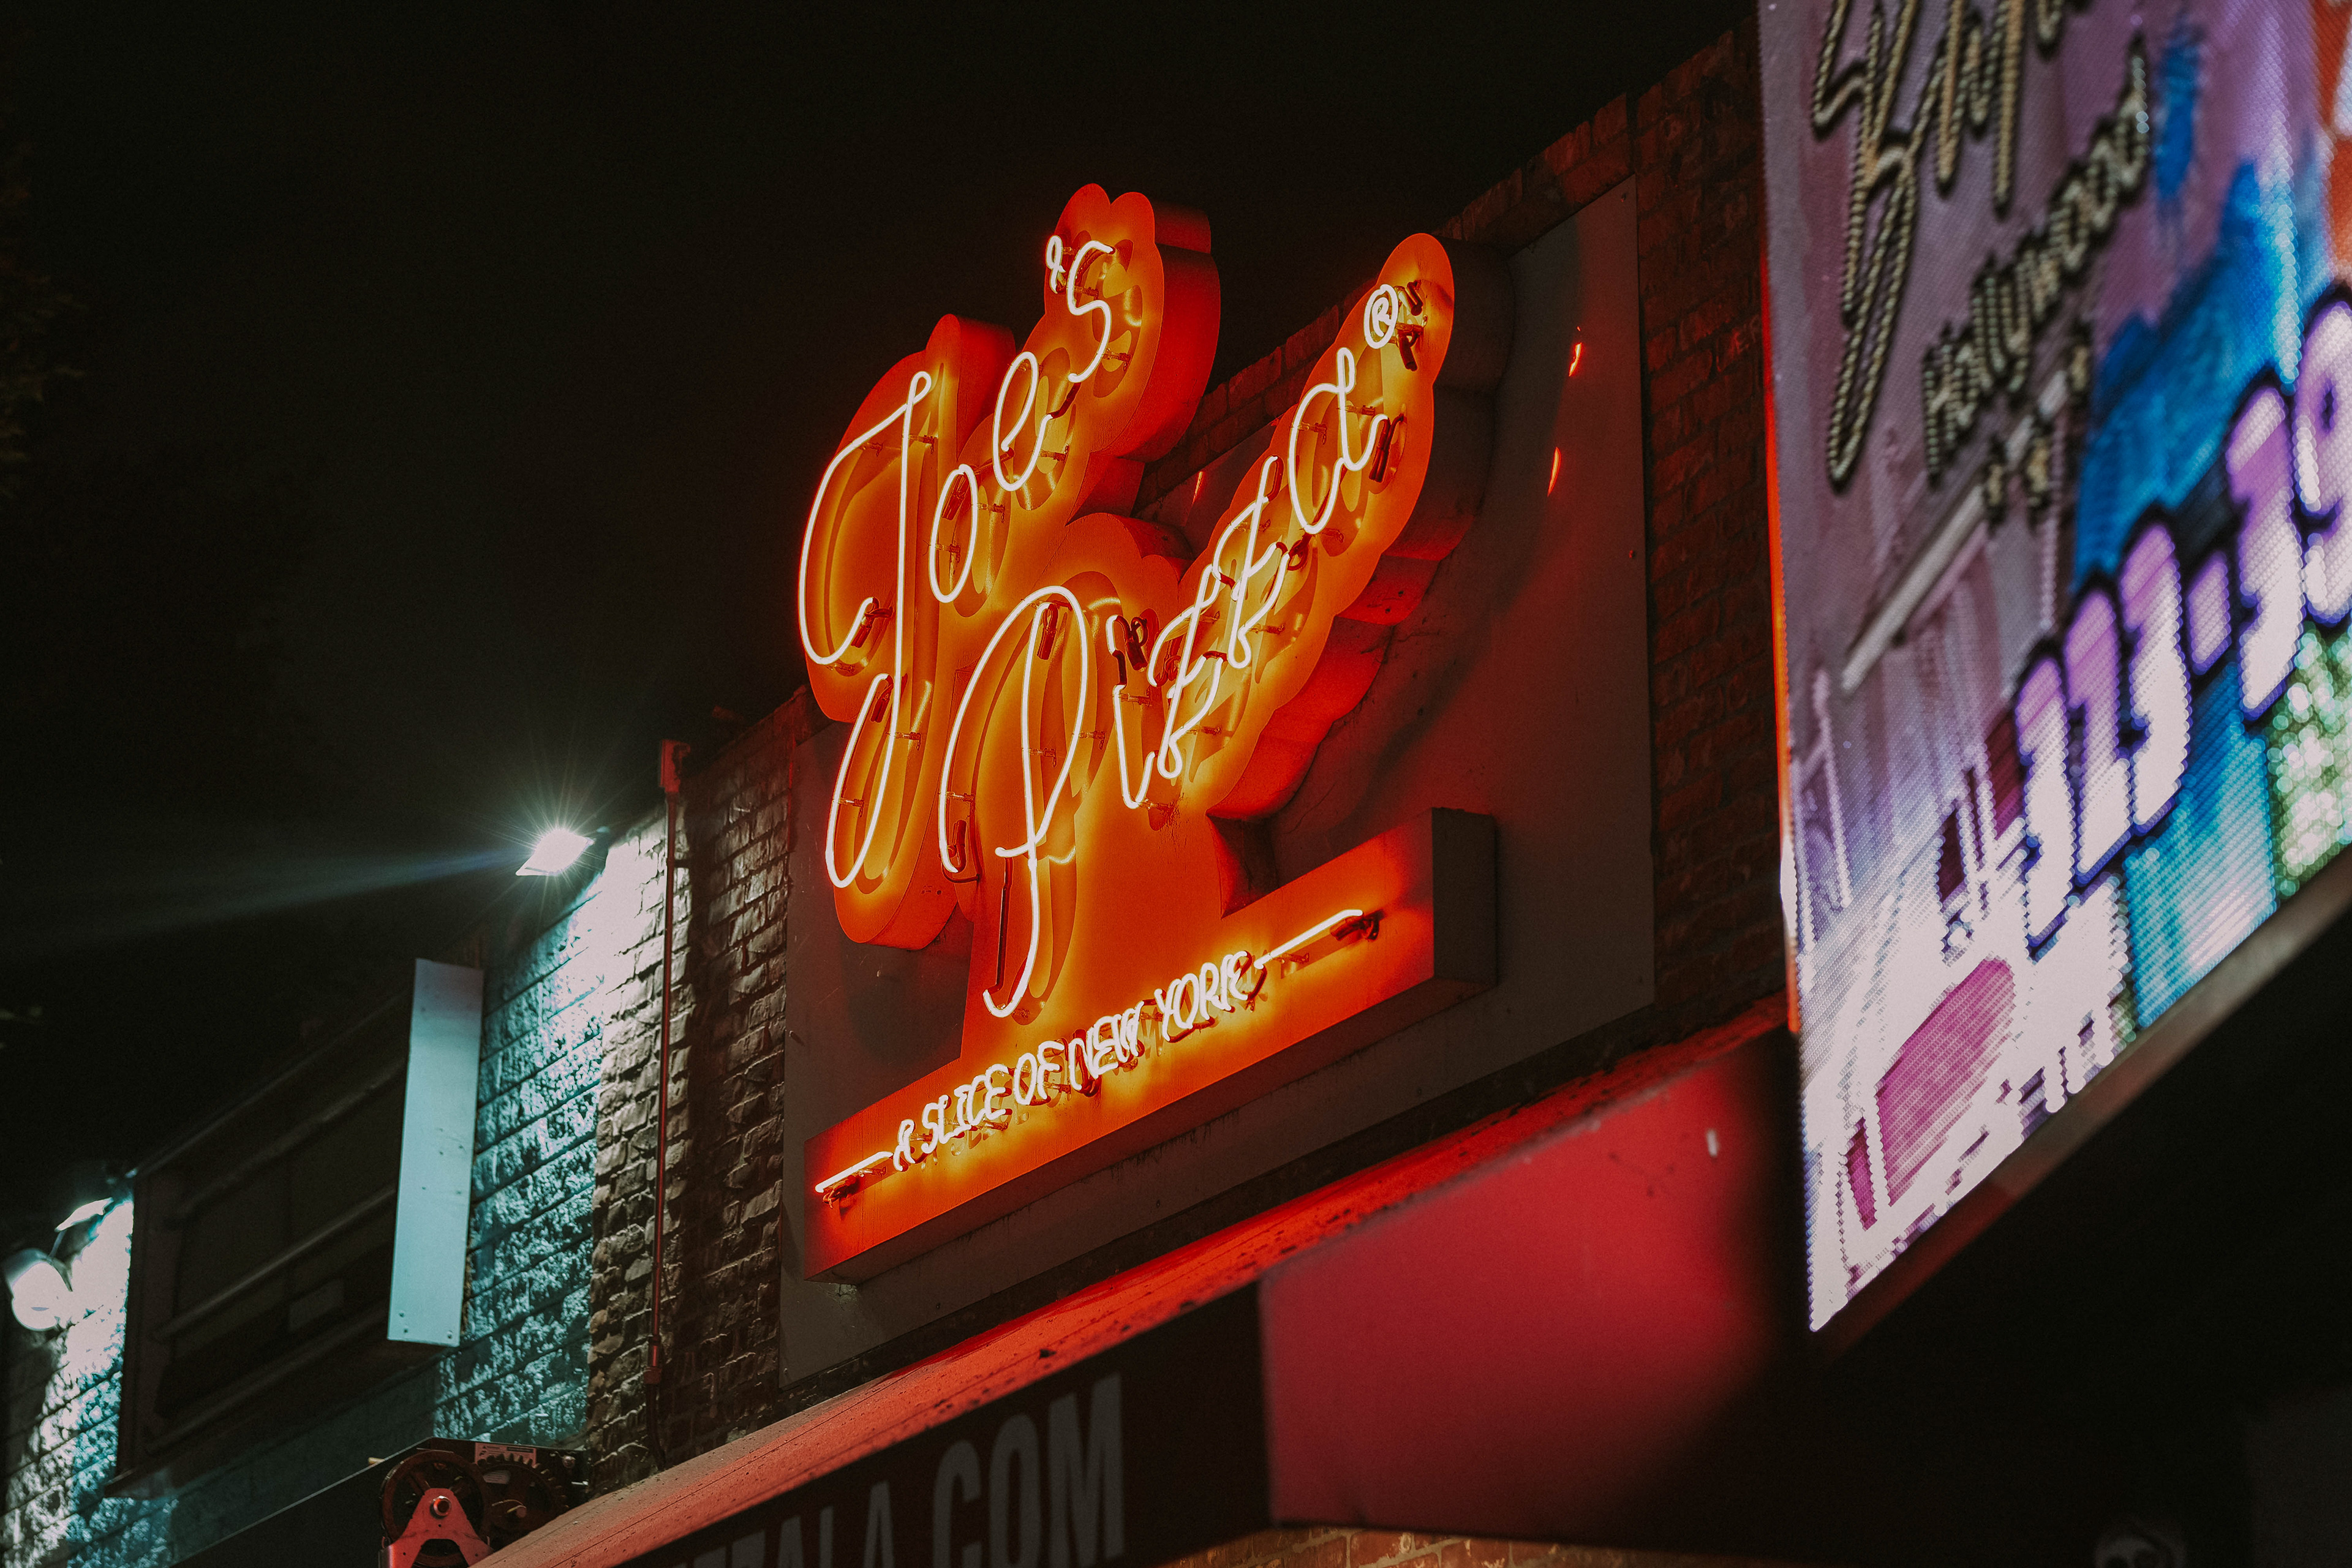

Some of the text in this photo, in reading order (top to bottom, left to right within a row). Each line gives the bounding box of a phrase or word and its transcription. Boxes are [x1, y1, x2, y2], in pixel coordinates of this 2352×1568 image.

[798, 235, 1116, 888] Joe's
[921, 1063, 1011, 1153] SLICE
[1014, 1041, 1066, 1106] OF
[1068, 1000, 1145, 1091] NEW
[1154, 950, 1251, 1041] YORK
